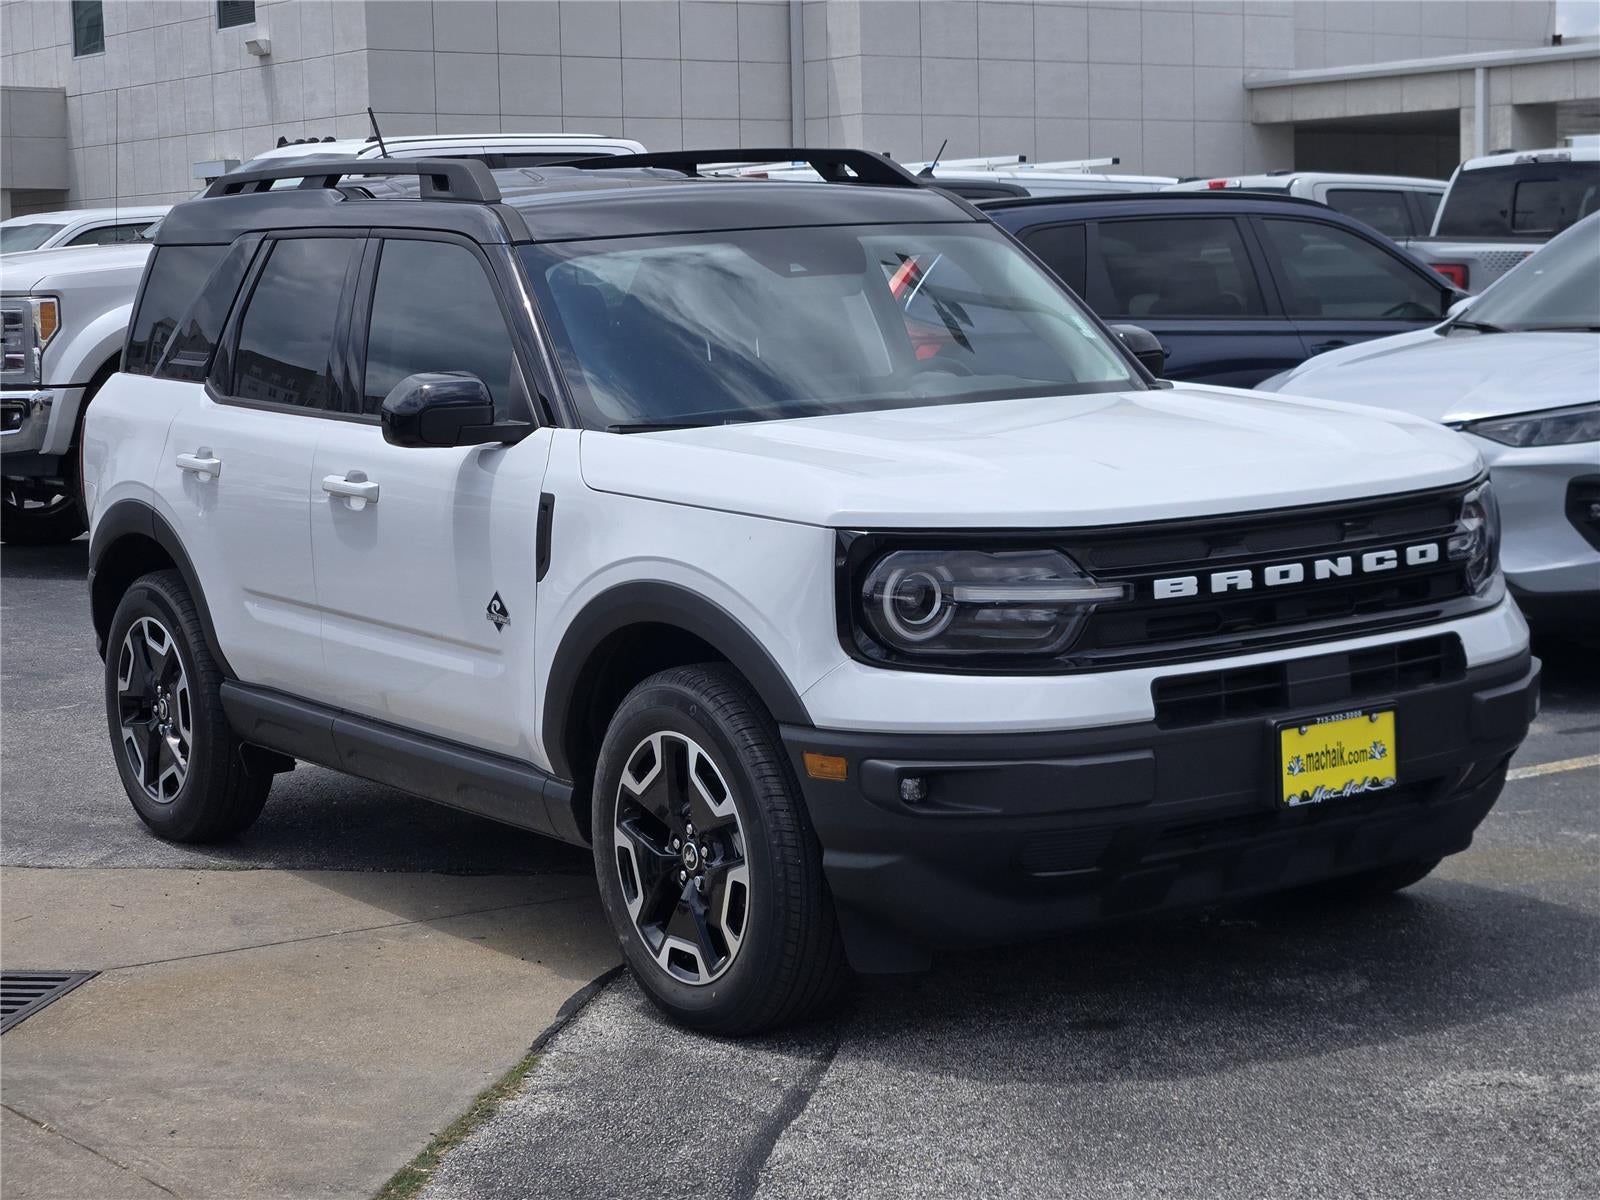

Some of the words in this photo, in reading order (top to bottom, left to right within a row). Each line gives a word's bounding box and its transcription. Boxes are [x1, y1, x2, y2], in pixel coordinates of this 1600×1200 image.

[1153, 543, 1439, 600] BRONCO
[1306, 742, 1368, 772] machaik.com
[1312, 786, 1338, 803] Mac
[1341, 777, 1372, 797] Haik
